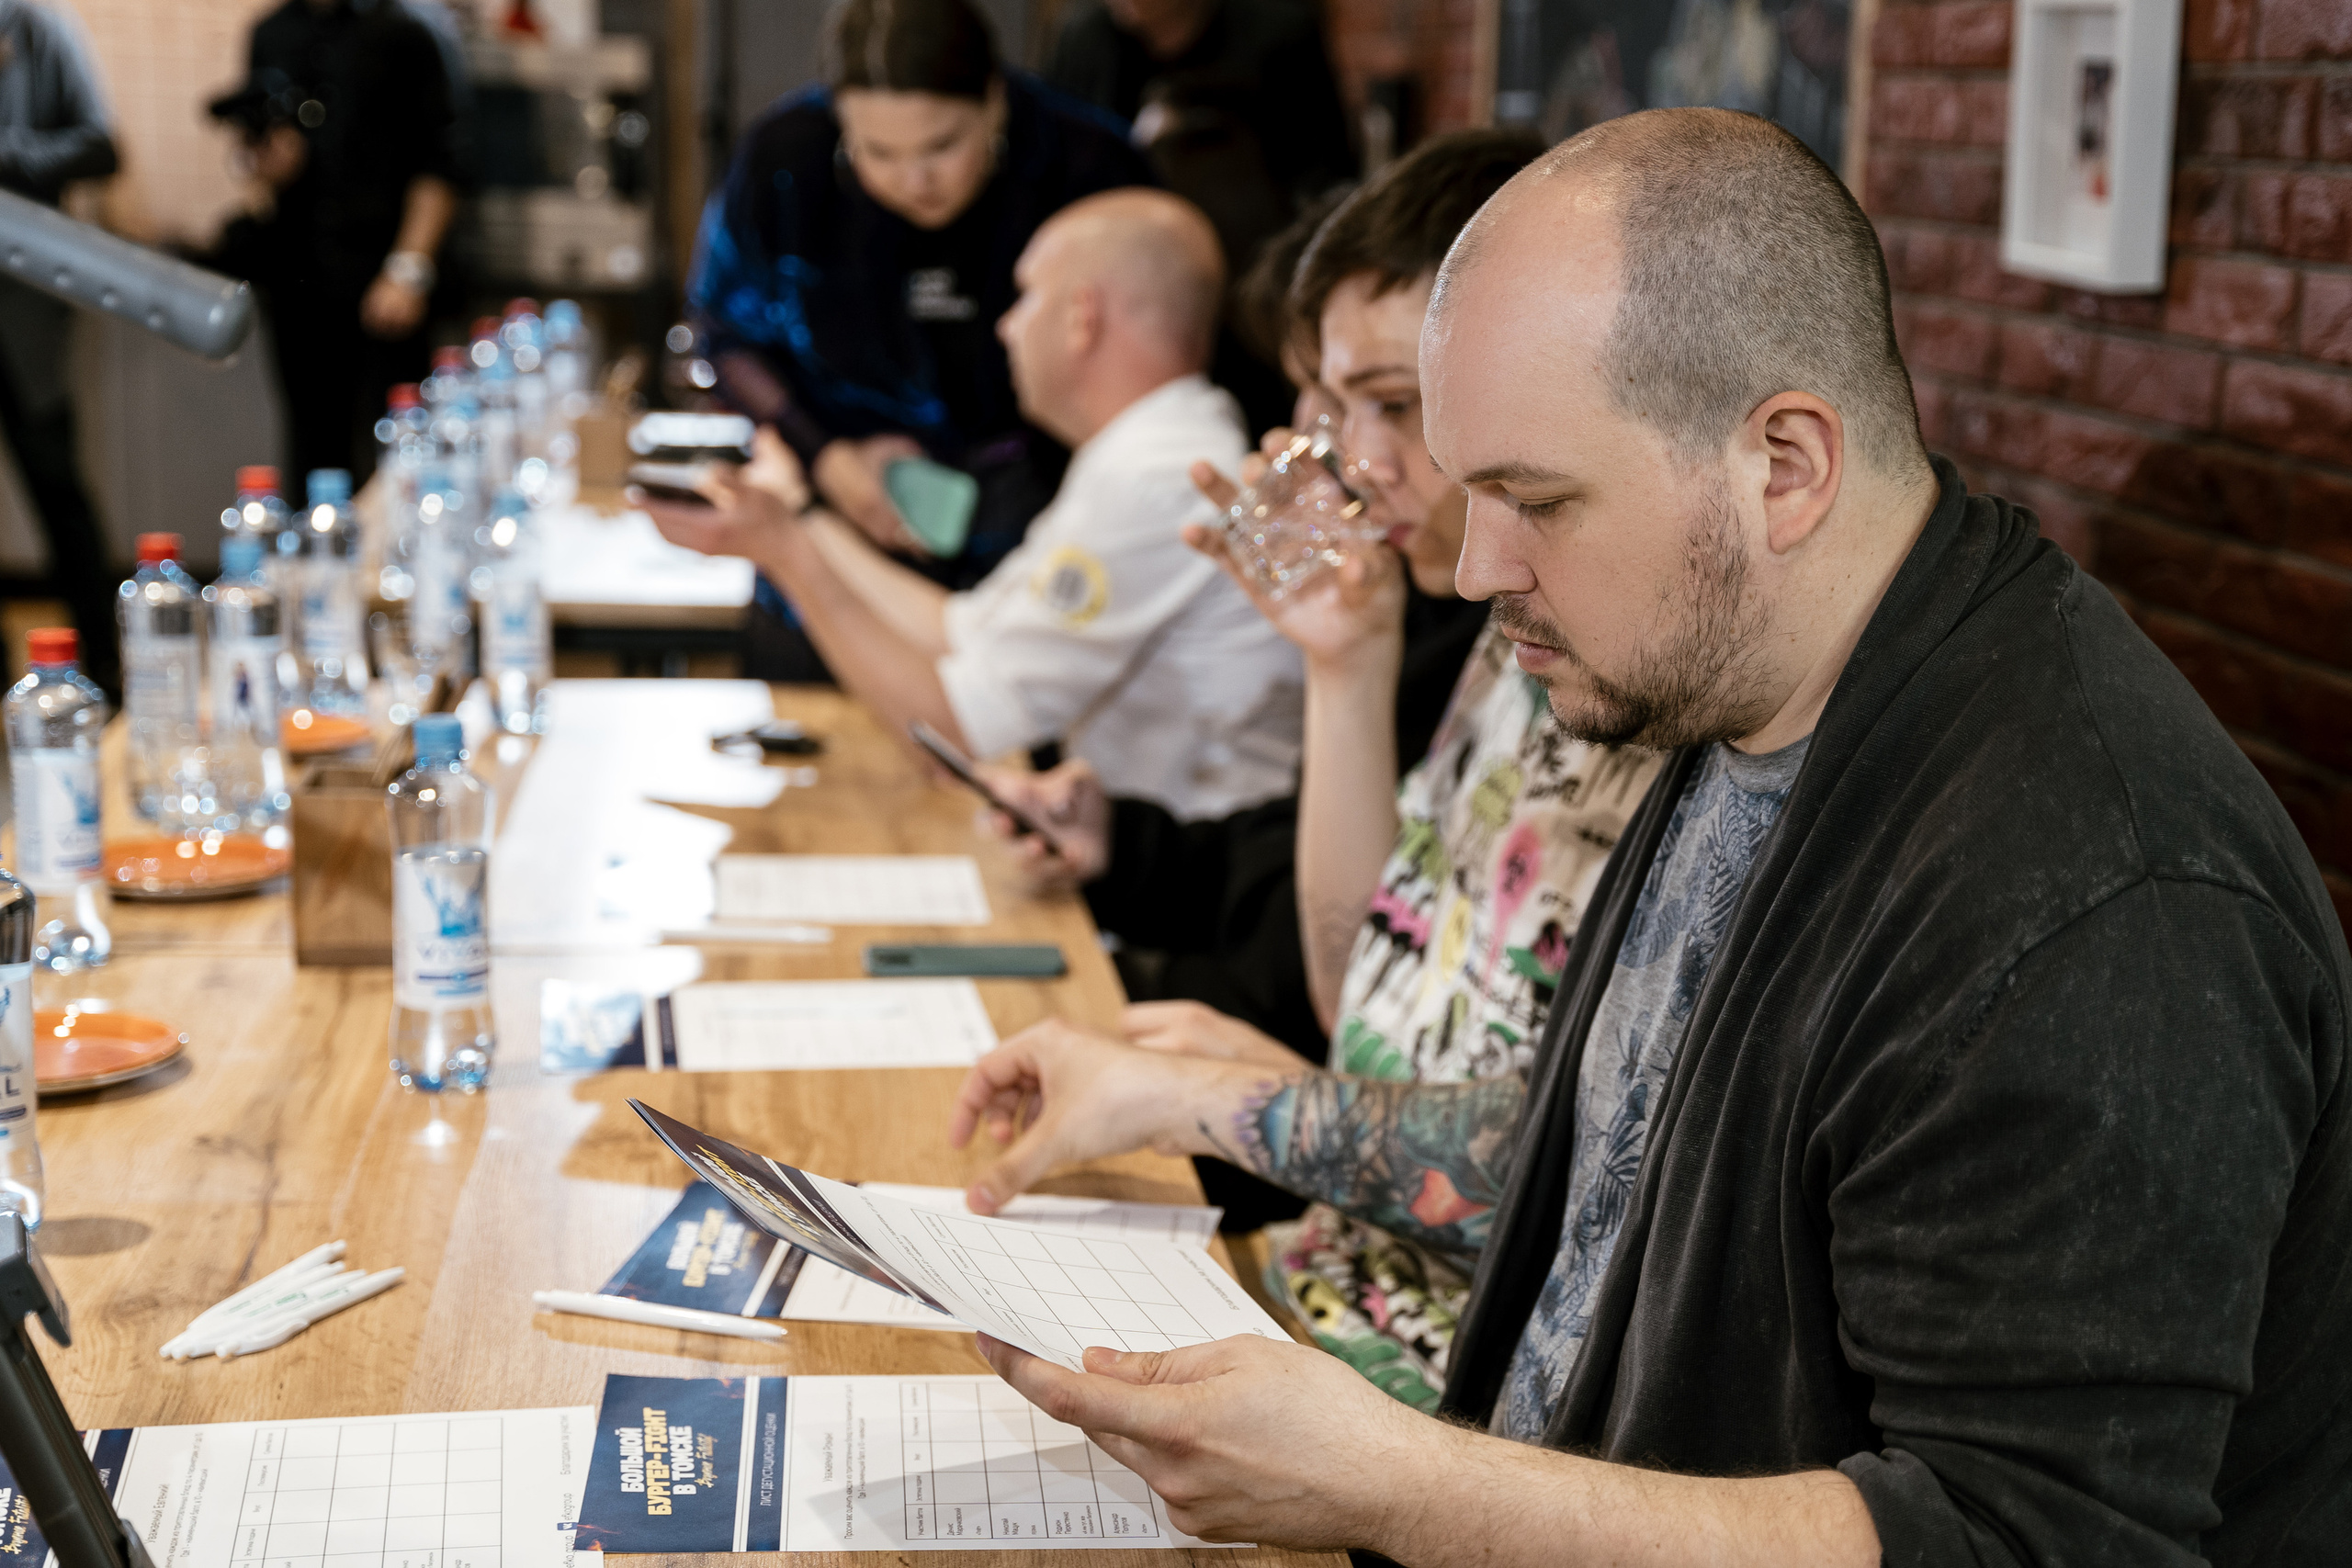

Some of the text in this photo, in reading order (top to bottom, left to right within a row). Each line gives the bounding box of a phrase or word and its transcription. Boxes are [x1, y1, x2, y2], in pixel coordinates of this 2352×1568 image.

[615, 1427, 645, 1493] БОЛЬШОЙ
[642, 1407, 673, 1516] БУРГЕР-FIGHT
[668, 1426, 697, 1495] В ТОМСКЕ
[761, 1437, 776, 1490] ДЕГУСТАЦИОННОЙ
[822, 1451, 833, 1483] Уважаемый
[561, 1493, 575, 1520] efkogroup
[760, 1490, 773, 1507] ЛИСТ
[143, 1509, 163, 1544] Уважаемый
[843, 1522, 854, 1540] Просим
[946, 1523, 956, 1536] Денис
[1001, 1518, 1011, 1535] Николай
[1112, 1513, 1121, 1534] Александр
